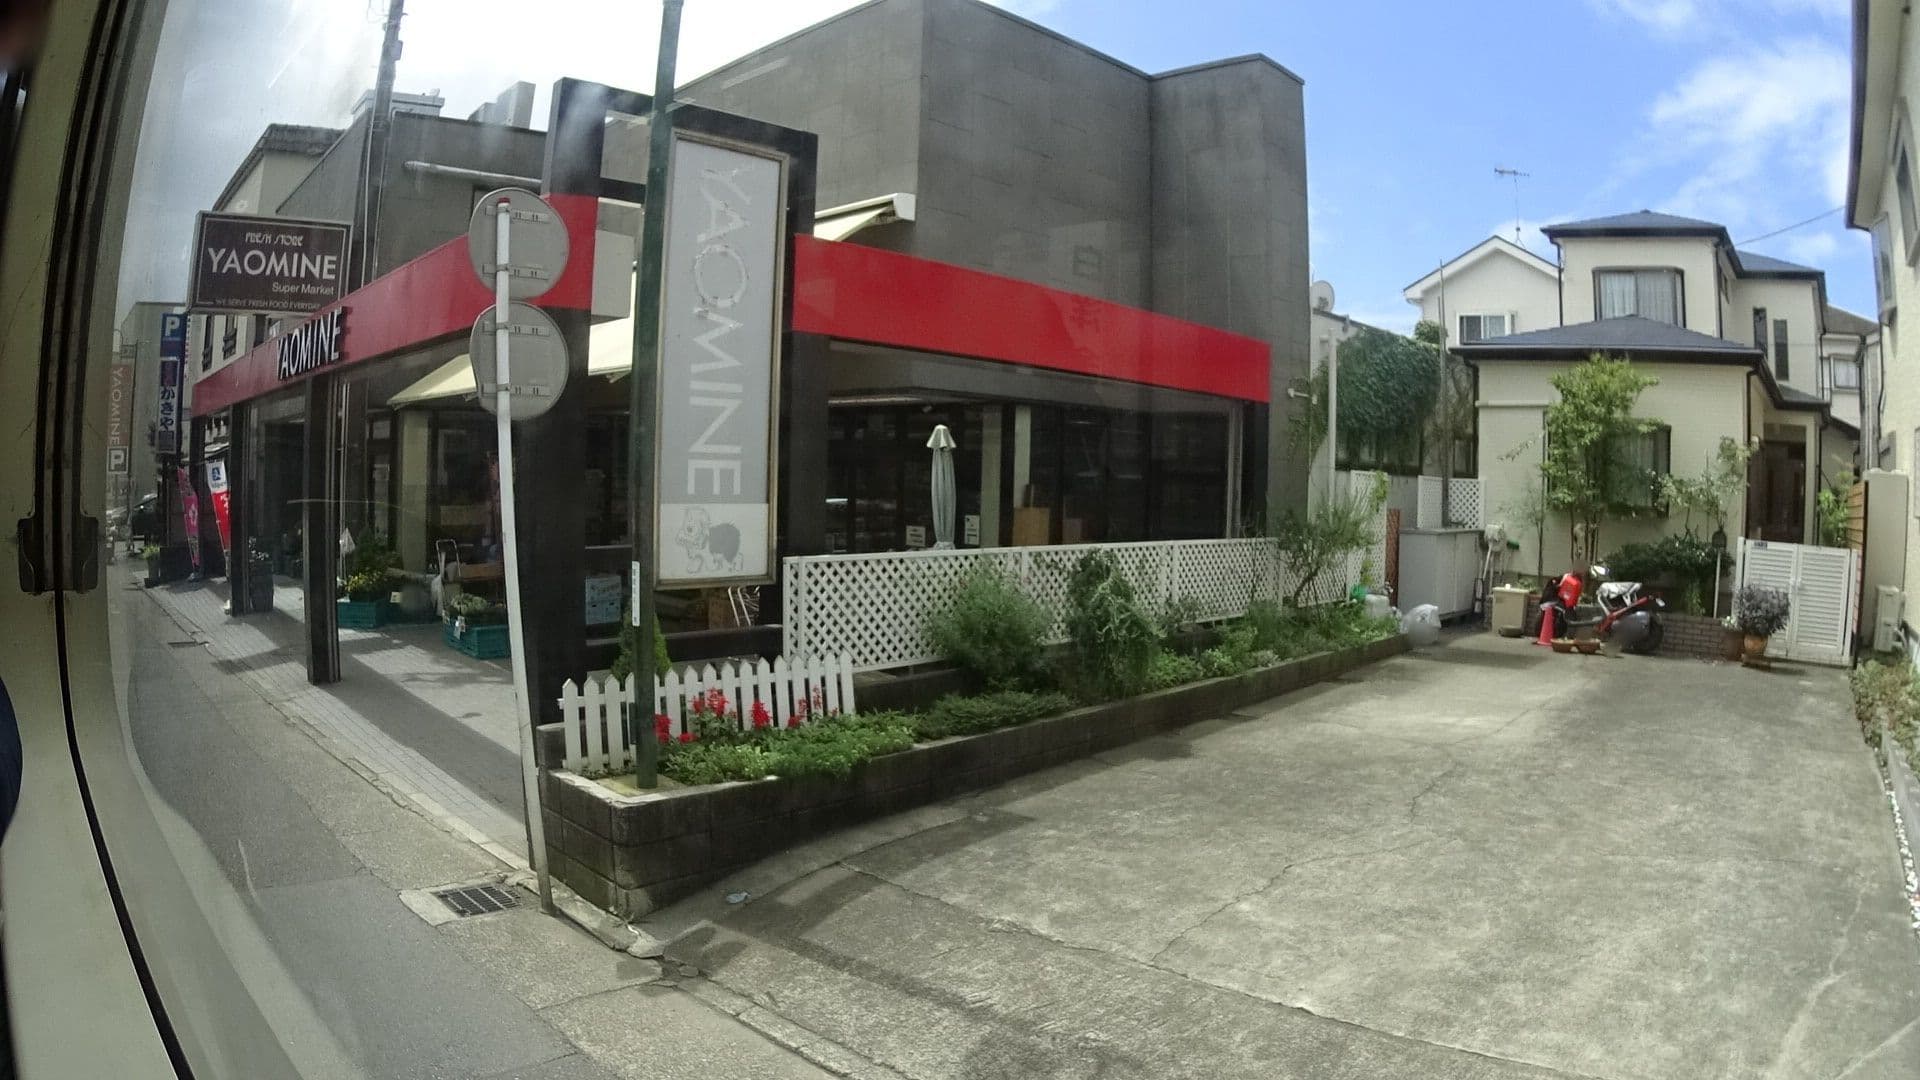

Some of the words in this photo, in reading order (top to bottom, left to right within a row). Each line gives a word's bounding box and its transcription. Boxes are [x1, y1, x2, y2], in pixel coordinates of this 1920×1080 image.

[207, 247, 337, 280] YAOMINE
[272, 282, 299, 295] Super
[301, 284, 334, 296] Market
[165, 316, 180, 336] P
[686, 167, 752, 496] YAOMINE
[276, 306, 342, 380] YAOMINE
[111, 367, 123, 446] YAOMINE
[110, 450, 124, 470] P
